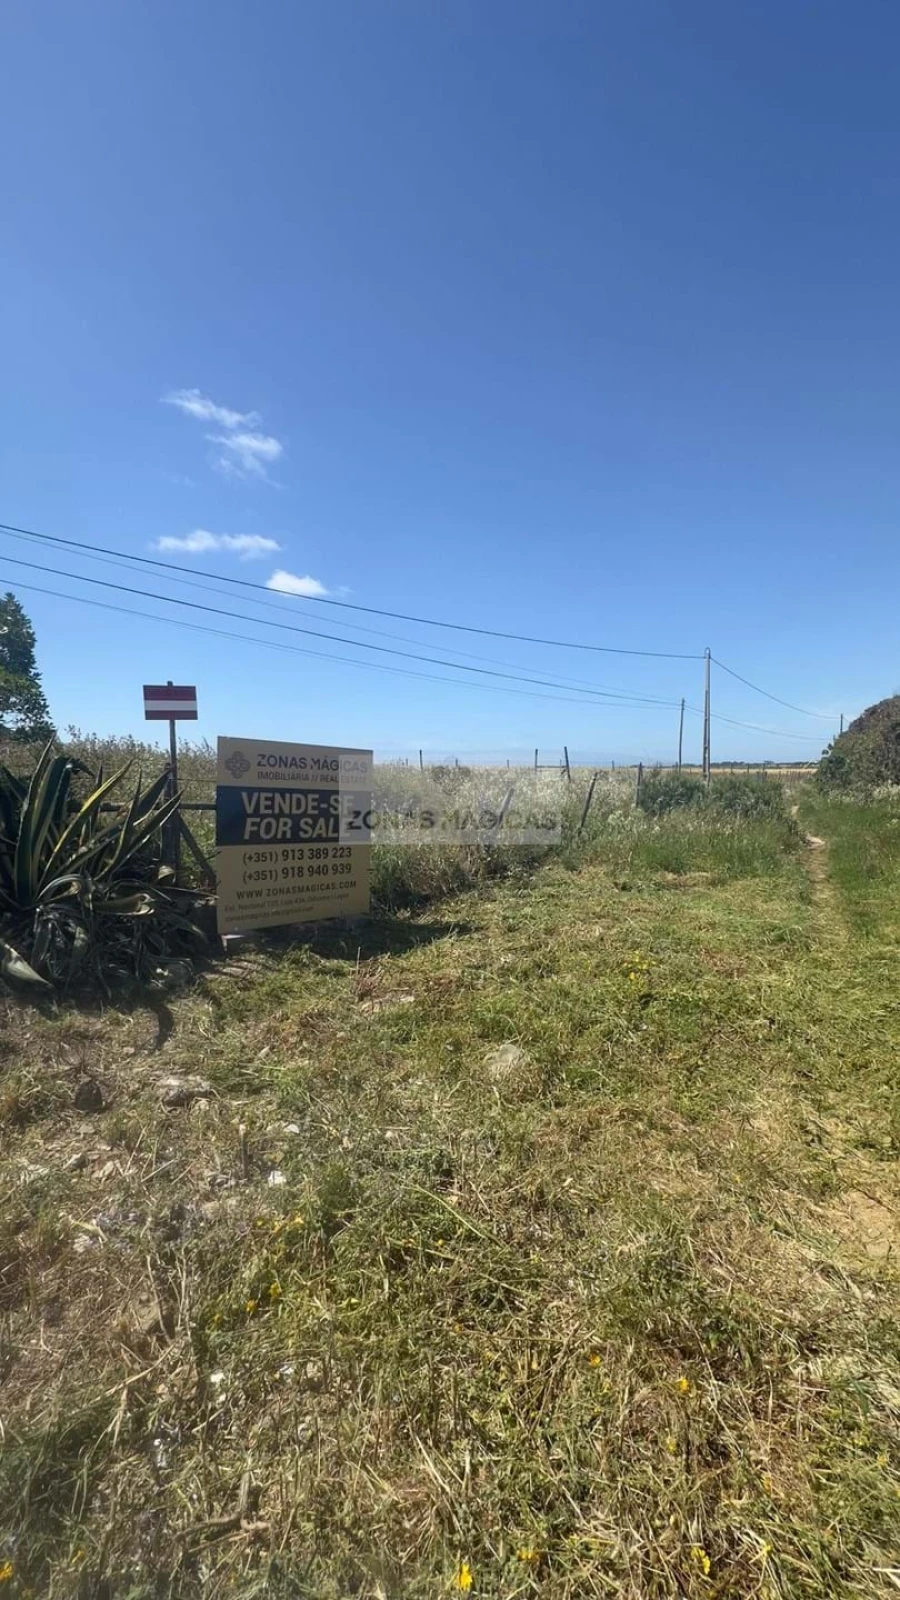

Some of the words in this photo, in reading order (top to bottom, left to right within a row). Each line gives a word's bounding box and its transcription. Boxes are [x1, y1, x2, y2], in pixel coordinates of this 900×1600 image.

[257, 754, 307, 770] ZONAS
[310, 755, 368, 773] MÁGICAS
[320, 774, 339, 783] REAL
[241, 792, 355, 815] VENDE-SE
[243, 817, 293, 840] FOR
[299, 817, 352, 838] SALE
[242, 851, 279, 866] (+351)
[281, 849, 305, 861] 913
[307, 848, 330, 860] 389
[331, 847, 353, 859] 223
[242, 869, 279, 885] (+351)
[281, 867, 304, 880] 918
[307, 864, 330, 878] 940
[331, 863, 353, 874] 939
[236, 880, 357, 900] WWWZONASMAGICAS.COM
